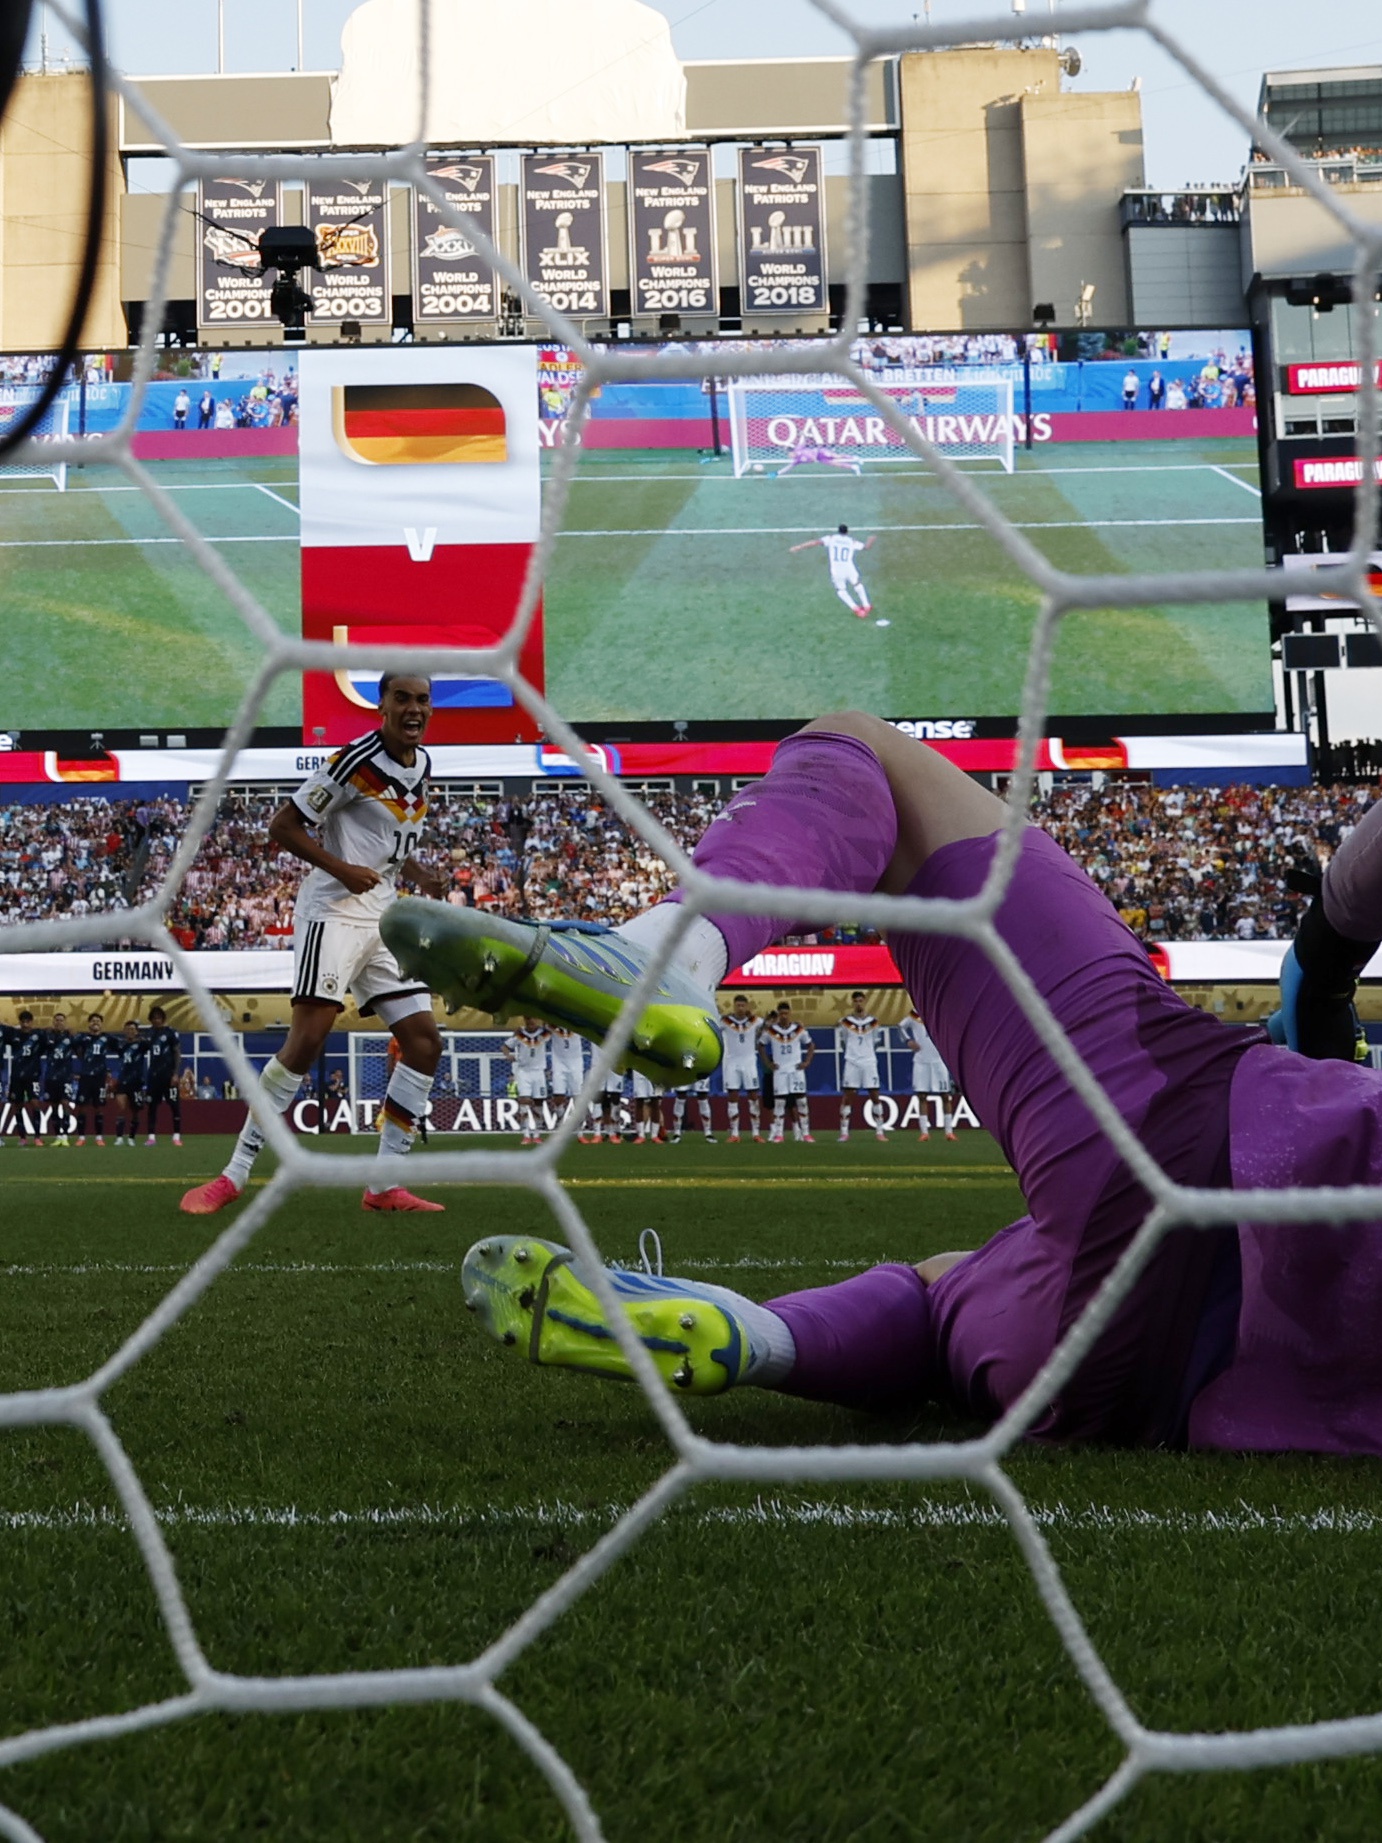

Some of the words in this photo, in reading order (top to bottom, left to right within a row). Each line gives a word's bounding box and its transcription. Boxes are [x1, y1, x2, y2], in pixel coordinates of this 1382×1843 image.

[527, 190, 550, 200] NEW
[552, 189, 598, 199] ENGLAND
[635, 187, 659, 197] NEW
[661, 186, 707, 196] ENGLAND
[744, 184, 768, 194] NEW
[770, 183, 817, 193] ENGLAND
[311, 196, 335, 205] NEW
[336, 195, 382, 205] ENGLAND
[445, 192, 490, 201] ENGLAND
[644, 197, 699, 207] PATRIOTS
[753, 193, 809, 204] PATRIOTS
[205, 199, 227, 208] NEW
[230, 198, 275, 207] ENGLAND
[535, 200, 591, 210] PATRIOTS
[213, 208, 267, 219] PATRIOTS
[538, 252, 590, 267] XLIX
[541, 269, 587, 281] WORLD
[651, 266, 697, 278] WORLD
[760, 263, 806, 275] WORLD
[218, 277, 262, 288] WORLD
[325, 274, 370, 285] WORLD
[433, 271, 479, 283] WORLD
[748, 275, 820, 287] CHAMPIONS
[420, 283, 492, 295] CHAMPIONS
[531, 280, 601, 292] CHAMPIONS
[639, 278, 710, 290] CHAMPIONS
[313, 286, 383, 298] CHAMPIONS
[753, 286, 816, 306] 2018
[422, 294, 492, 314] 2004
[644, 290, 707, 309] 2016
[209, 301, 272, 319] 2001
[314, 298, 382, 317] 2003
[1297, 365, 1380, 388] PARAGUY
[767, 417, 888, 447] QATAR
[403, 527, 438, 562] V
[888, 720, 972, 739] ense
[388, 831, 419, 864] 10
[93, 961, 174, 980] GERMANY
[742, 953, 835, 976] PARAGUAY
[863, 1095, 981, 1131] QATA
